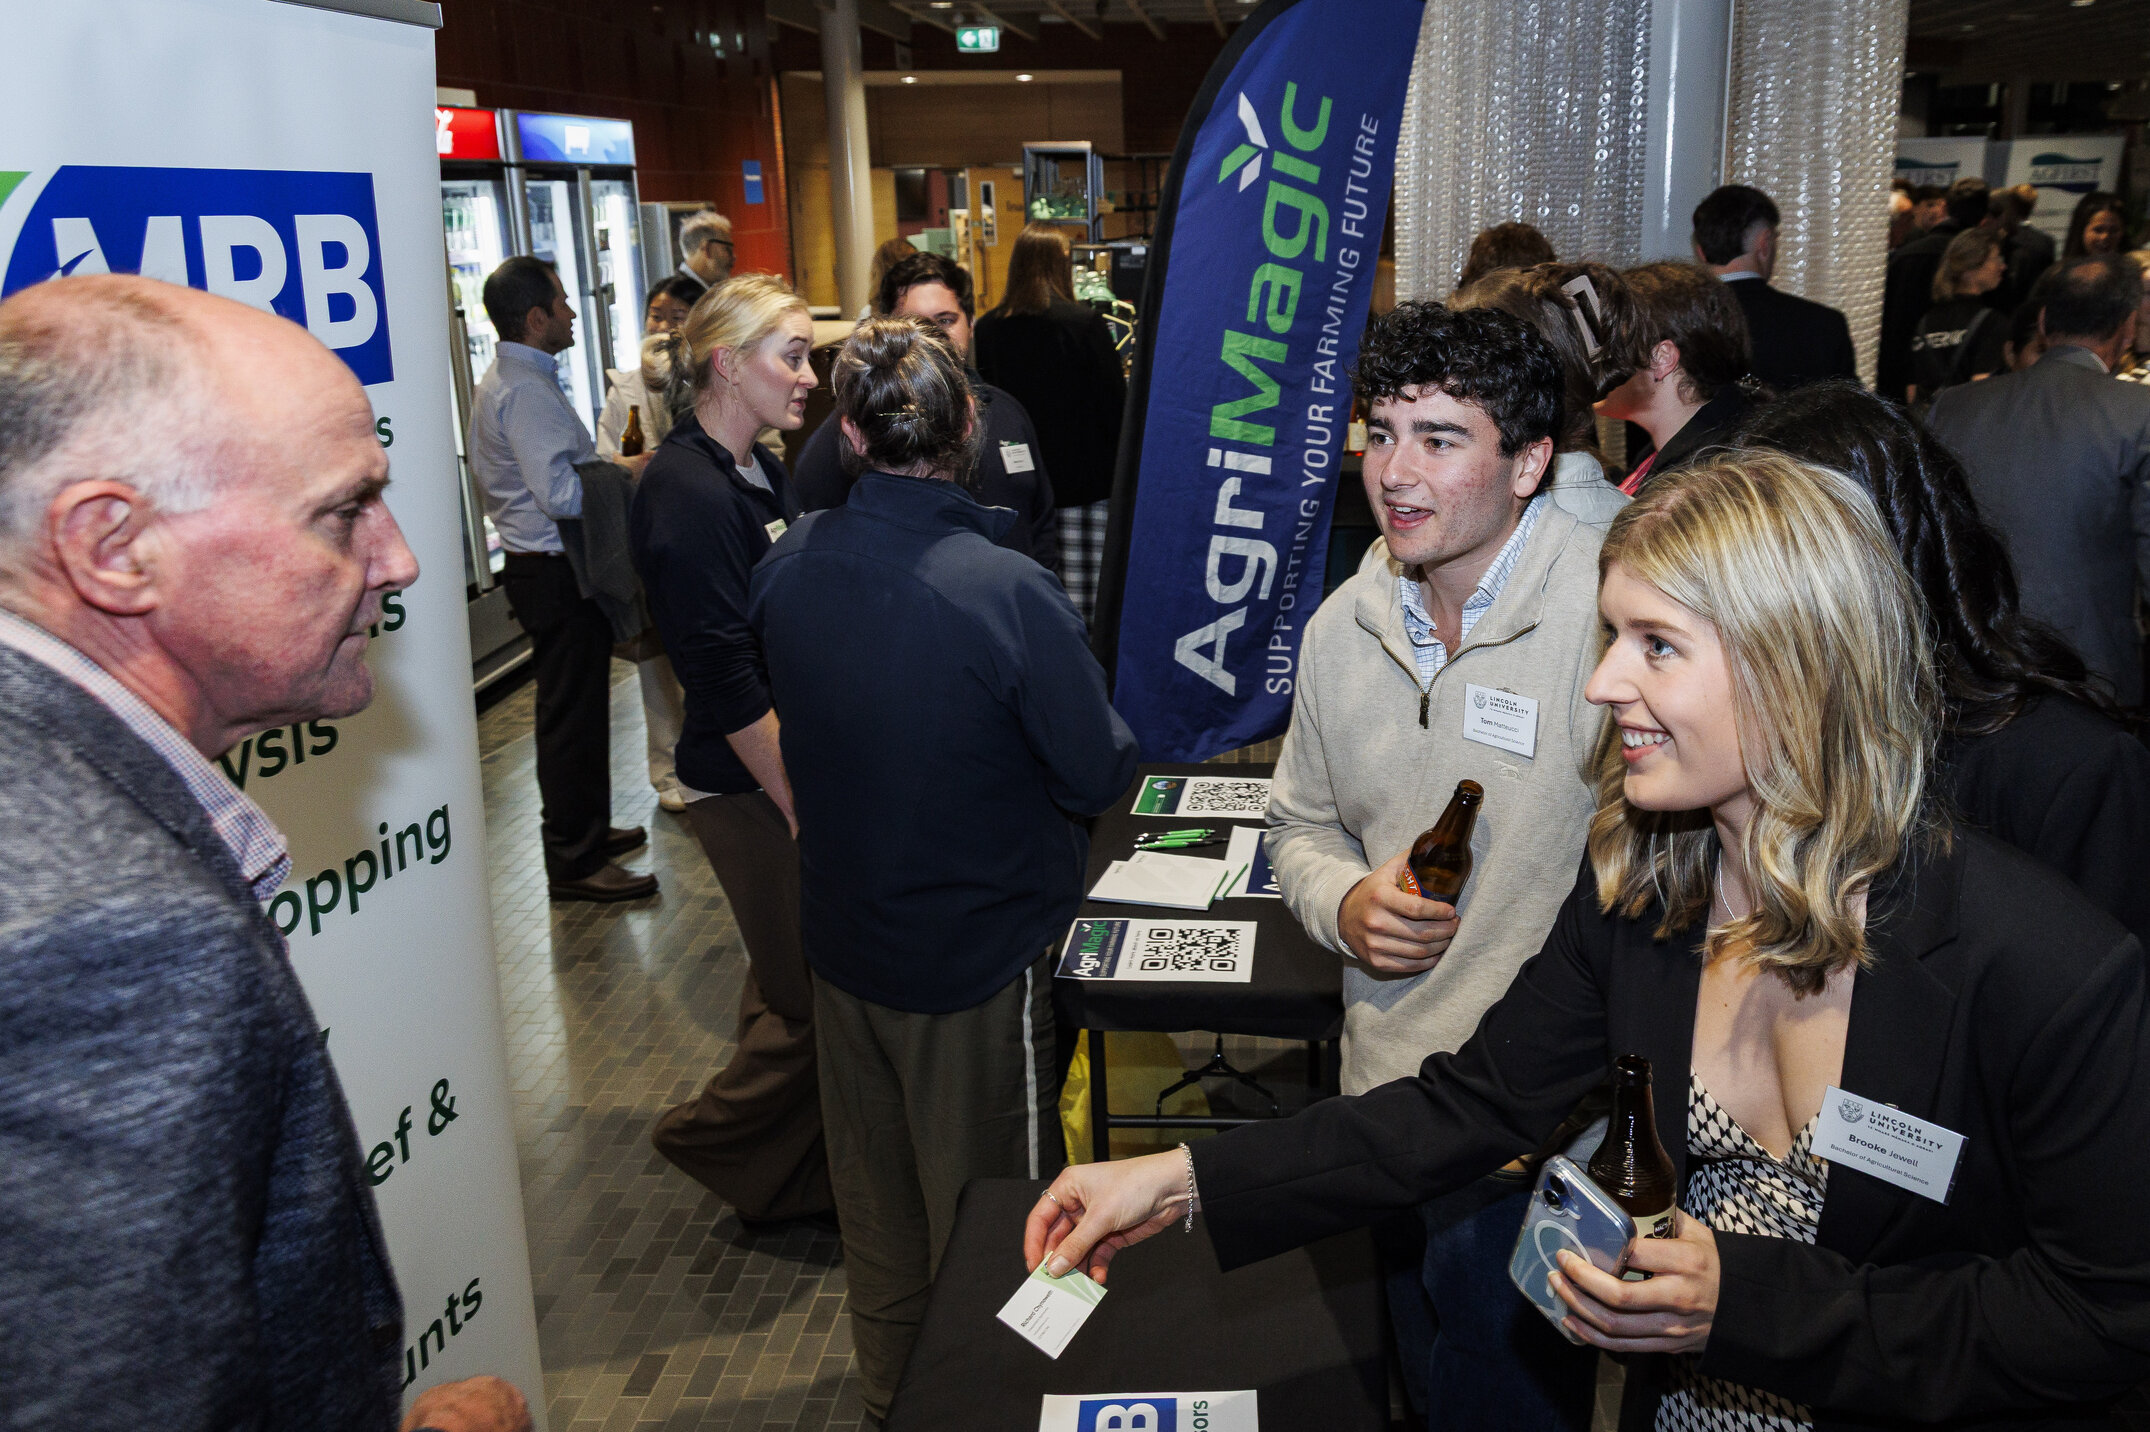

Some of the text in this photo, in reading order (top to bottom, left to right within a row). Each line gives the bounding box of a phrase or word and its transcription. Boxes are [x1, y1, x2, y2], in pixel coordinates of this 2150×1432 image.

[1174, 80, 1333, 697] AgriMagic
[1266, 113, 1379, 695] SUPPORTING YOUR FARMING FUTURE
[1489, 696, 1518, 706] LINCOLN
[1489, 702, 1529, 715] UNIVERSITY
[1480, 717, 1493, 725] Tom
[267, 803, 451, 936] opping
[1072, 921, 1110, 977] AgriMagic
[1869, 1117, 1943, 1150] UNIVERSITY
[1870, 1110, 1922, 1135] LINCOLN
[1830, 1143, 1858, 1158] Bachelor
[1866, 1156, 1903, 1175] Agricultural
[1903, 1171, 1929, 1186] Science
[1848, 1133, 1919, 1168] Brooke Jewell
